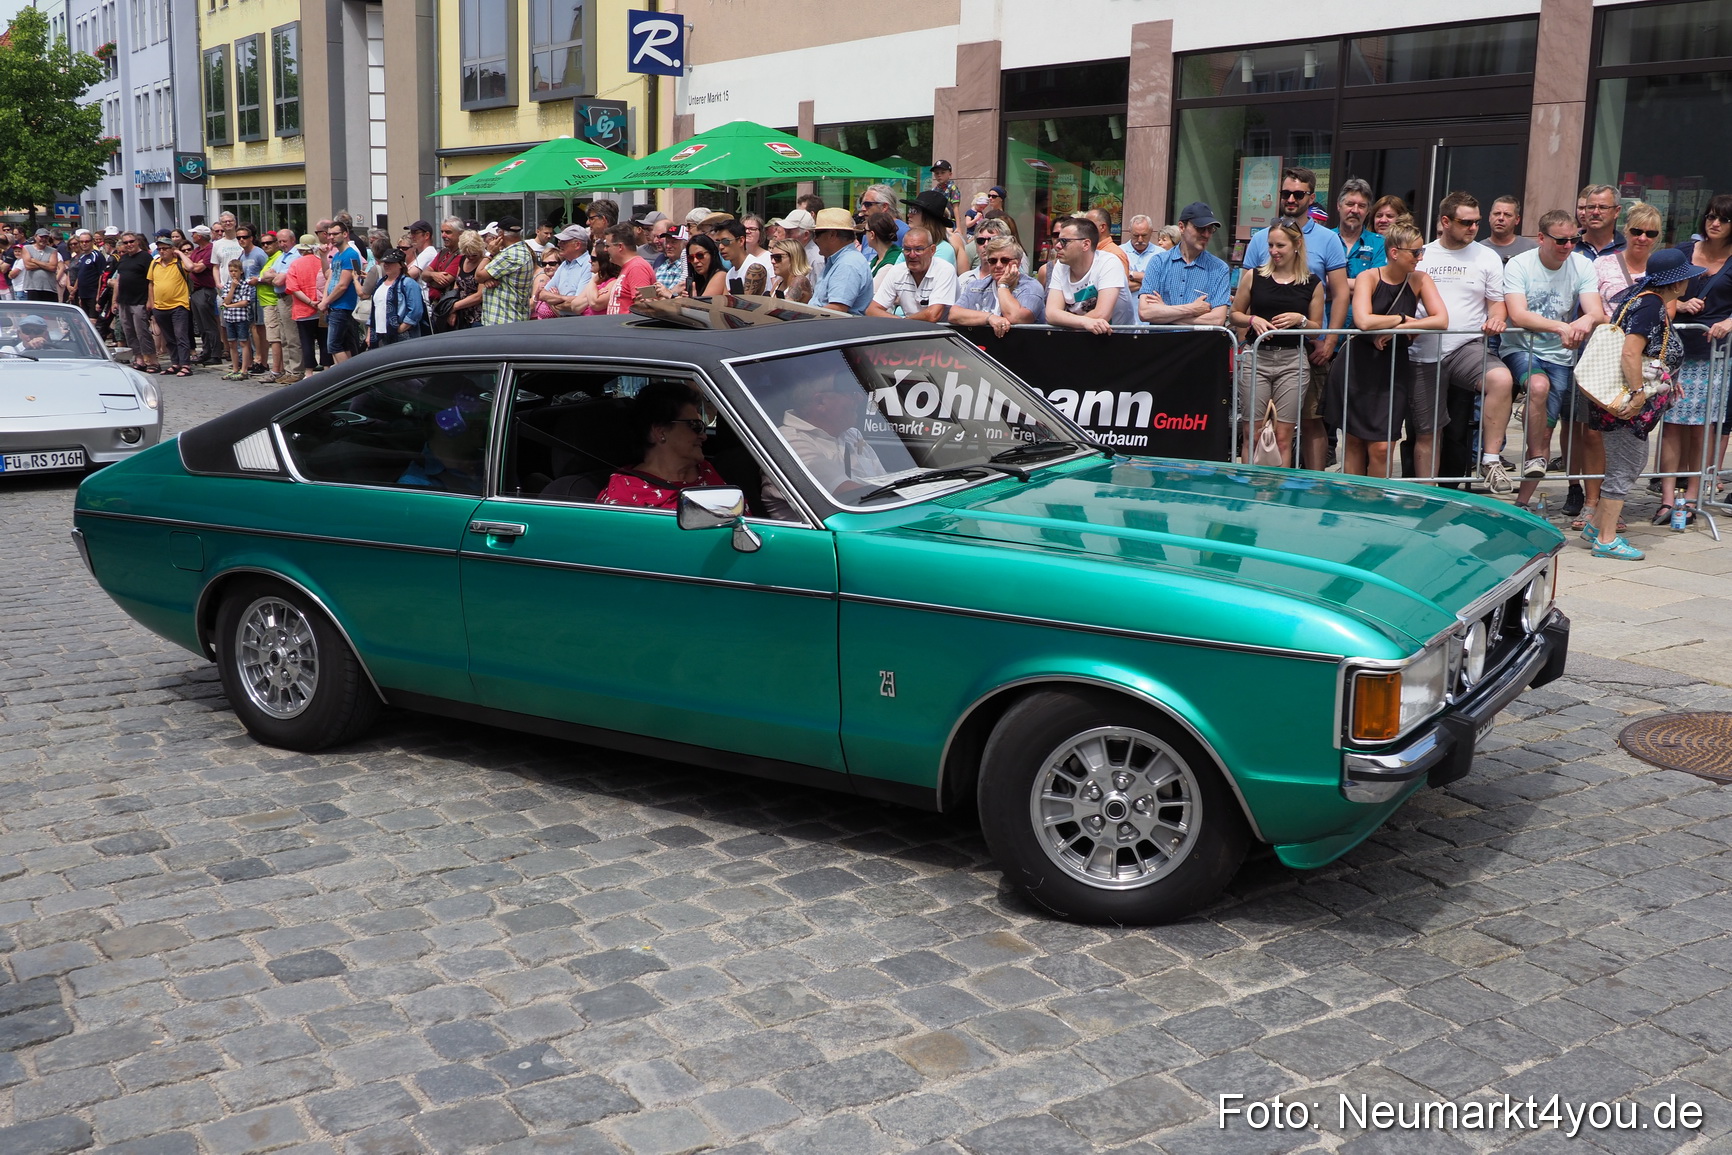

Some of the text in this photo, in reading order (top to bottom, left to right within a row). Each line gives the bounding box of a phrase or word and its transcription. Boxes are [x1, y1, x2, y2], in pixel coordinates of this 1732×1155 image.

[688, 90, 729, 106] Unterer Markt 15
[596, 115, 615, 138] G2
[186, 160, 198, 173] G2
[1094, 166, 1121, 176] Grillen
[864, 418, 924, 436] Neumarkt
[1153, 412, 1208, 431] GmbH
[31, 453, 48, 468] RS
[51, 452, 83, 467] 916H
